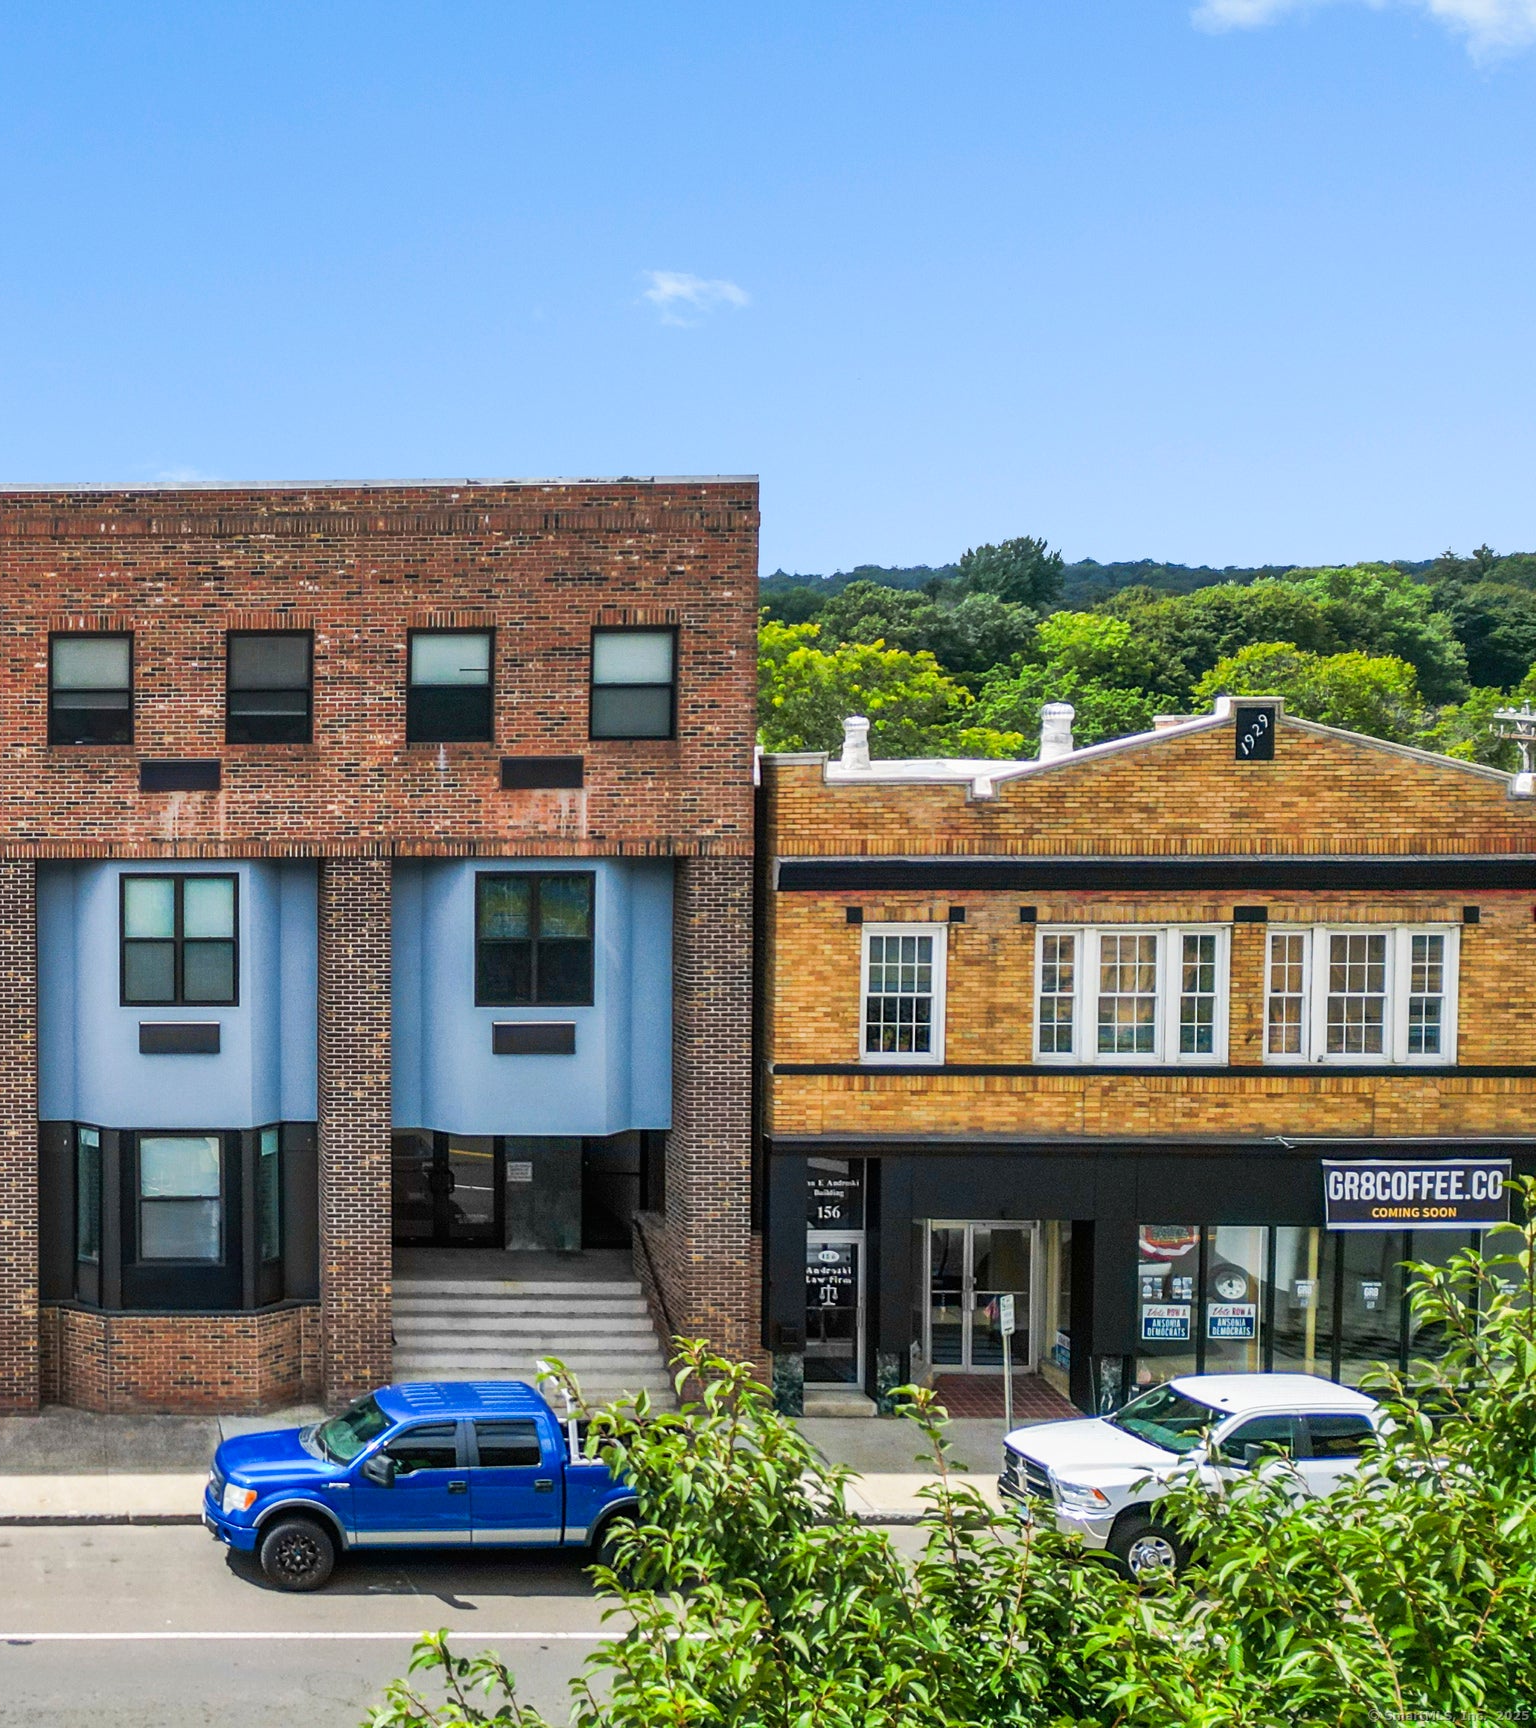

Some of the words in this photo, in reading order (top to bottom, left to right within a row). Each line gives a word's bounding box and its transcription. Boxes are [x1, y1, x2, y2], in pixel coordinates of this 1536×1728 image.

[1241, 714, 1268, 755] 1929
[1329, 1171, 1503, 1200] GR8COFFEE.CO
[817, 1205, 841, 1219] 156
[1371, 1208, 1420, 1218] COMING
[1422, 1208, 1457, 1218] SOON
[1152, 1318, 1181, 1327] ANSONIA
[1217, 1318, 1246, 1327] ANSONIA
[1147, 1327, 1186, 1337] DEMOCRATS
[1212, 1326, 1251, 1336] DEMOCRATS
